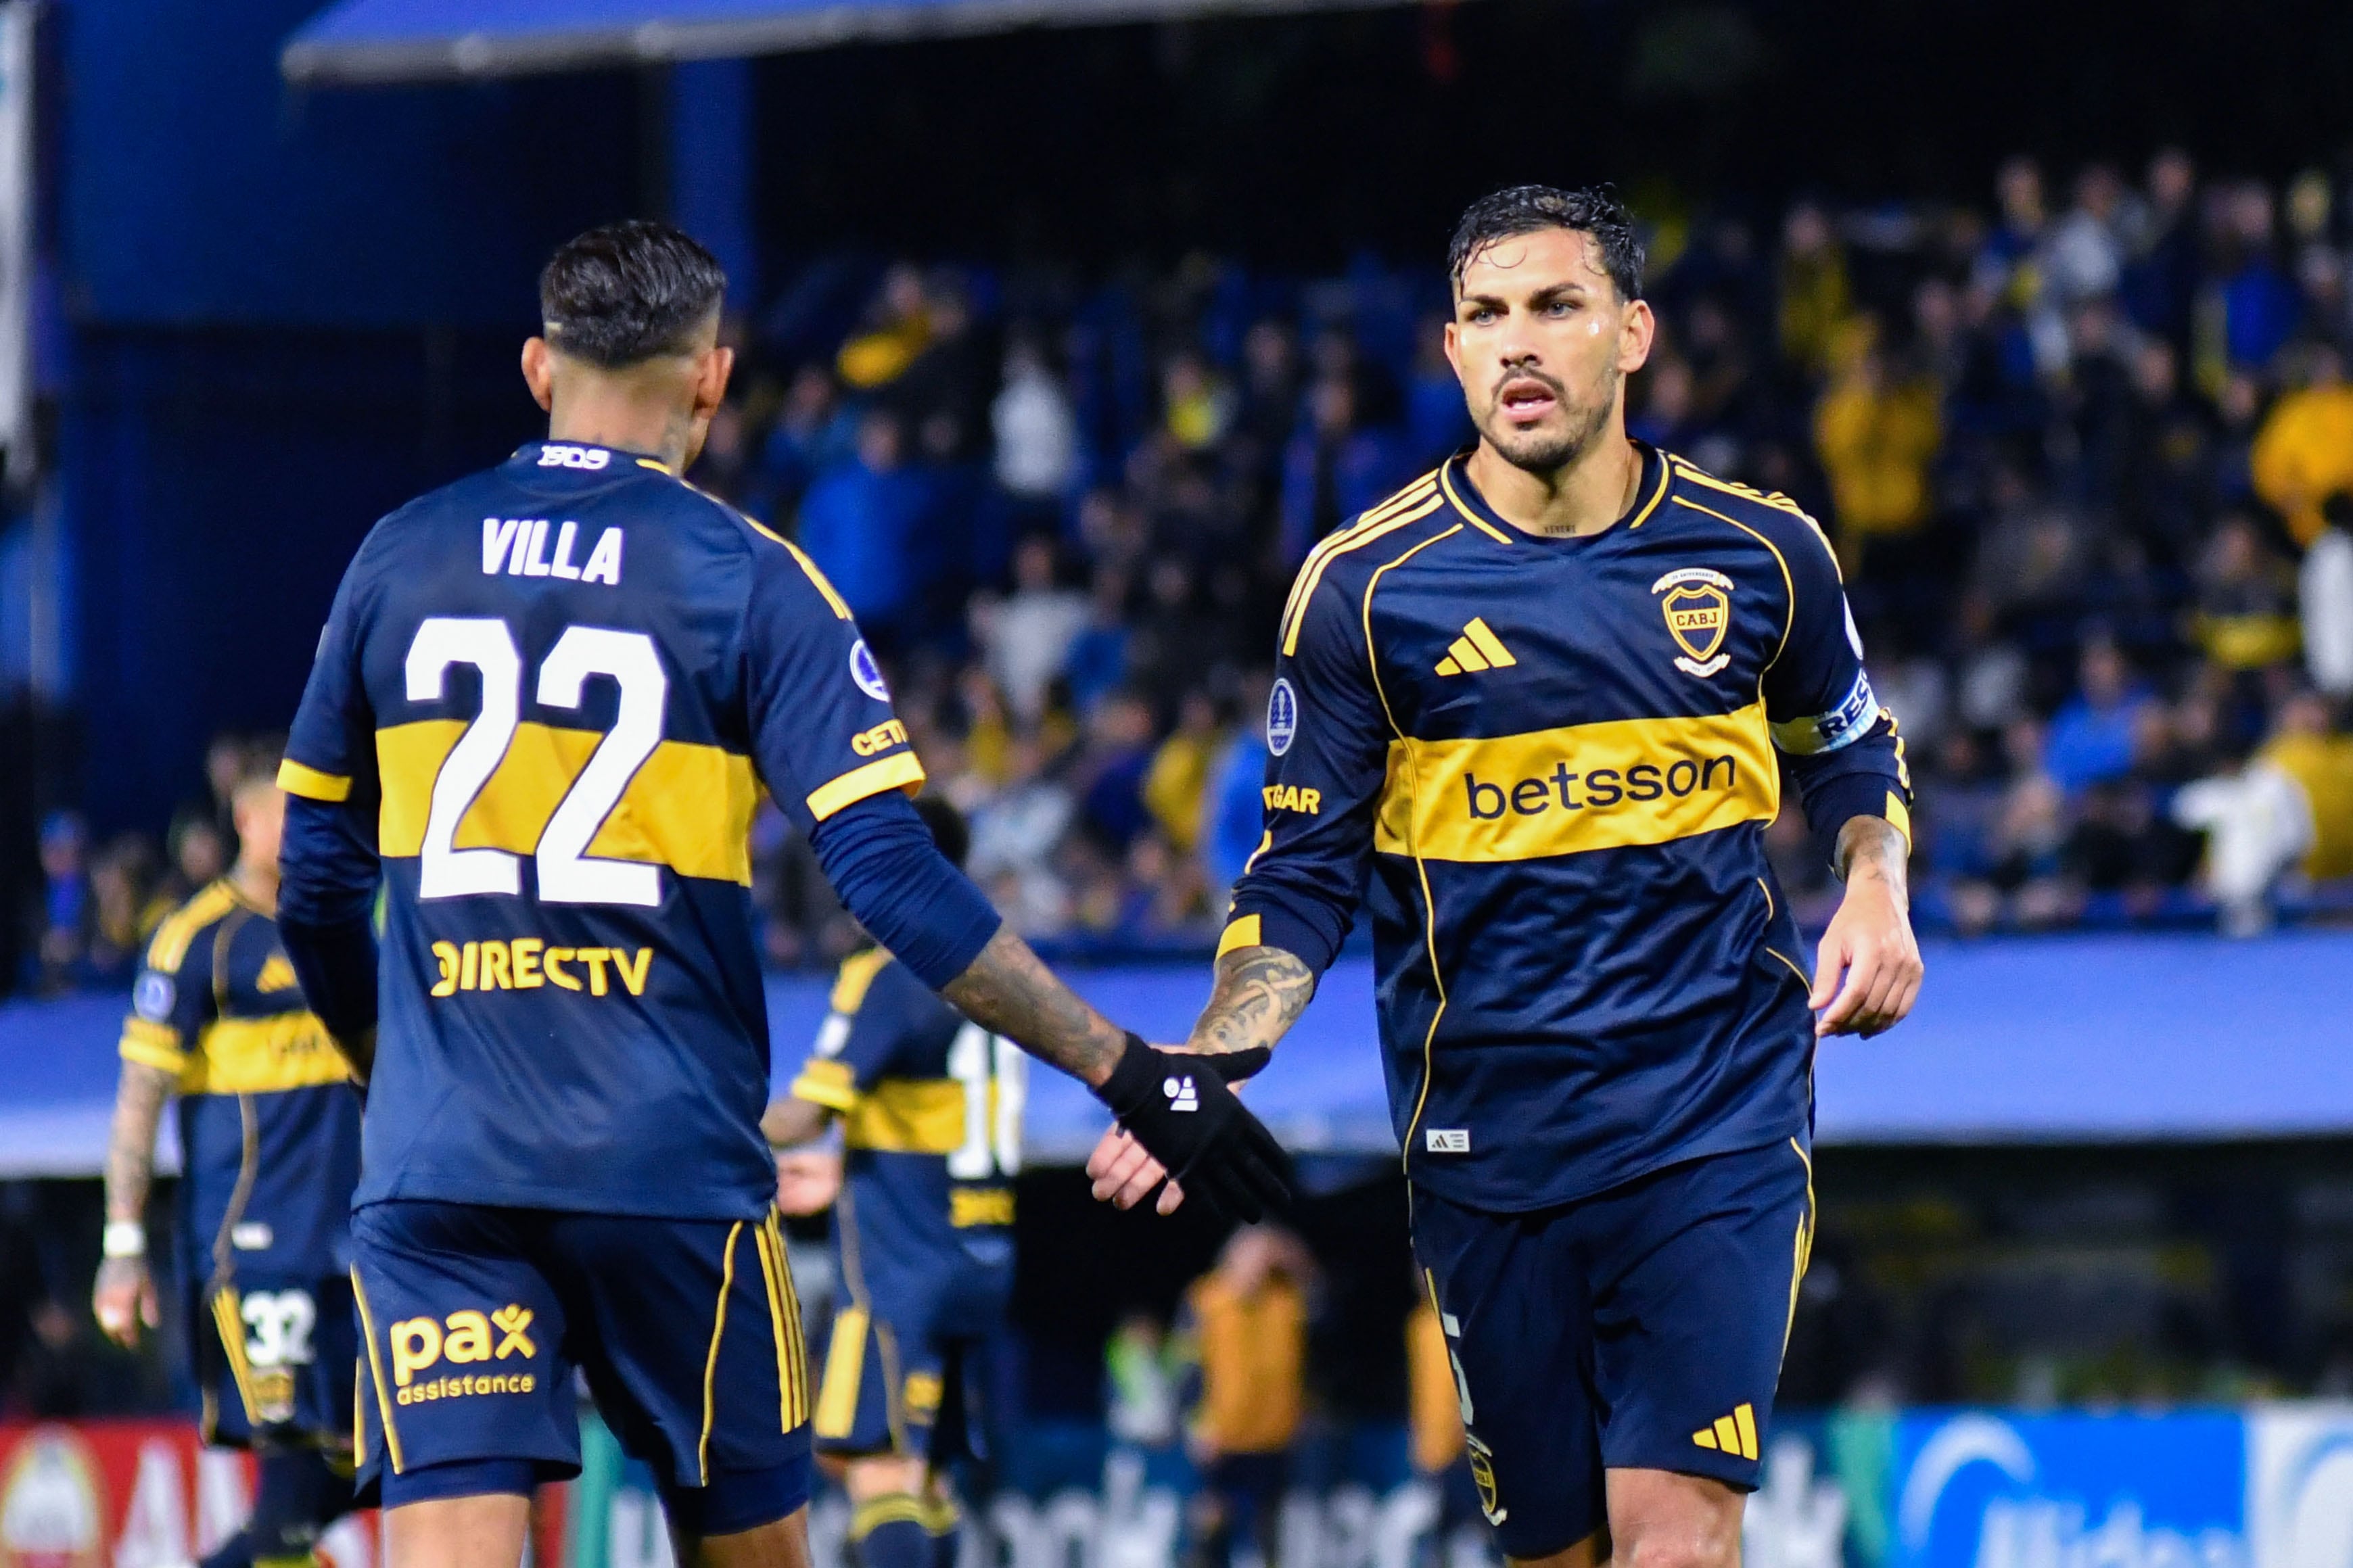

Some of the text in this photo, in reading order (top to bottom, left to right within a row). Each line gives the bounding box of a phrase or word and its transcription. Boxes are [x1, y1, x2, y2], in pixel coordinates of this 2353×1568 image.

[483, 518, 624, 585] VILLA
[1676, 611, 1717, 626] CABJ
[405, 617, 667, 907] 22
[1464, 755, 1735, 820] betsson
[431, 938, 653, 997] DIRECTV
[242, 1289, 317, 1366] 32
[390, 1303, 536, 1387] pax
[396, 1374, 536, 1406] assistance
